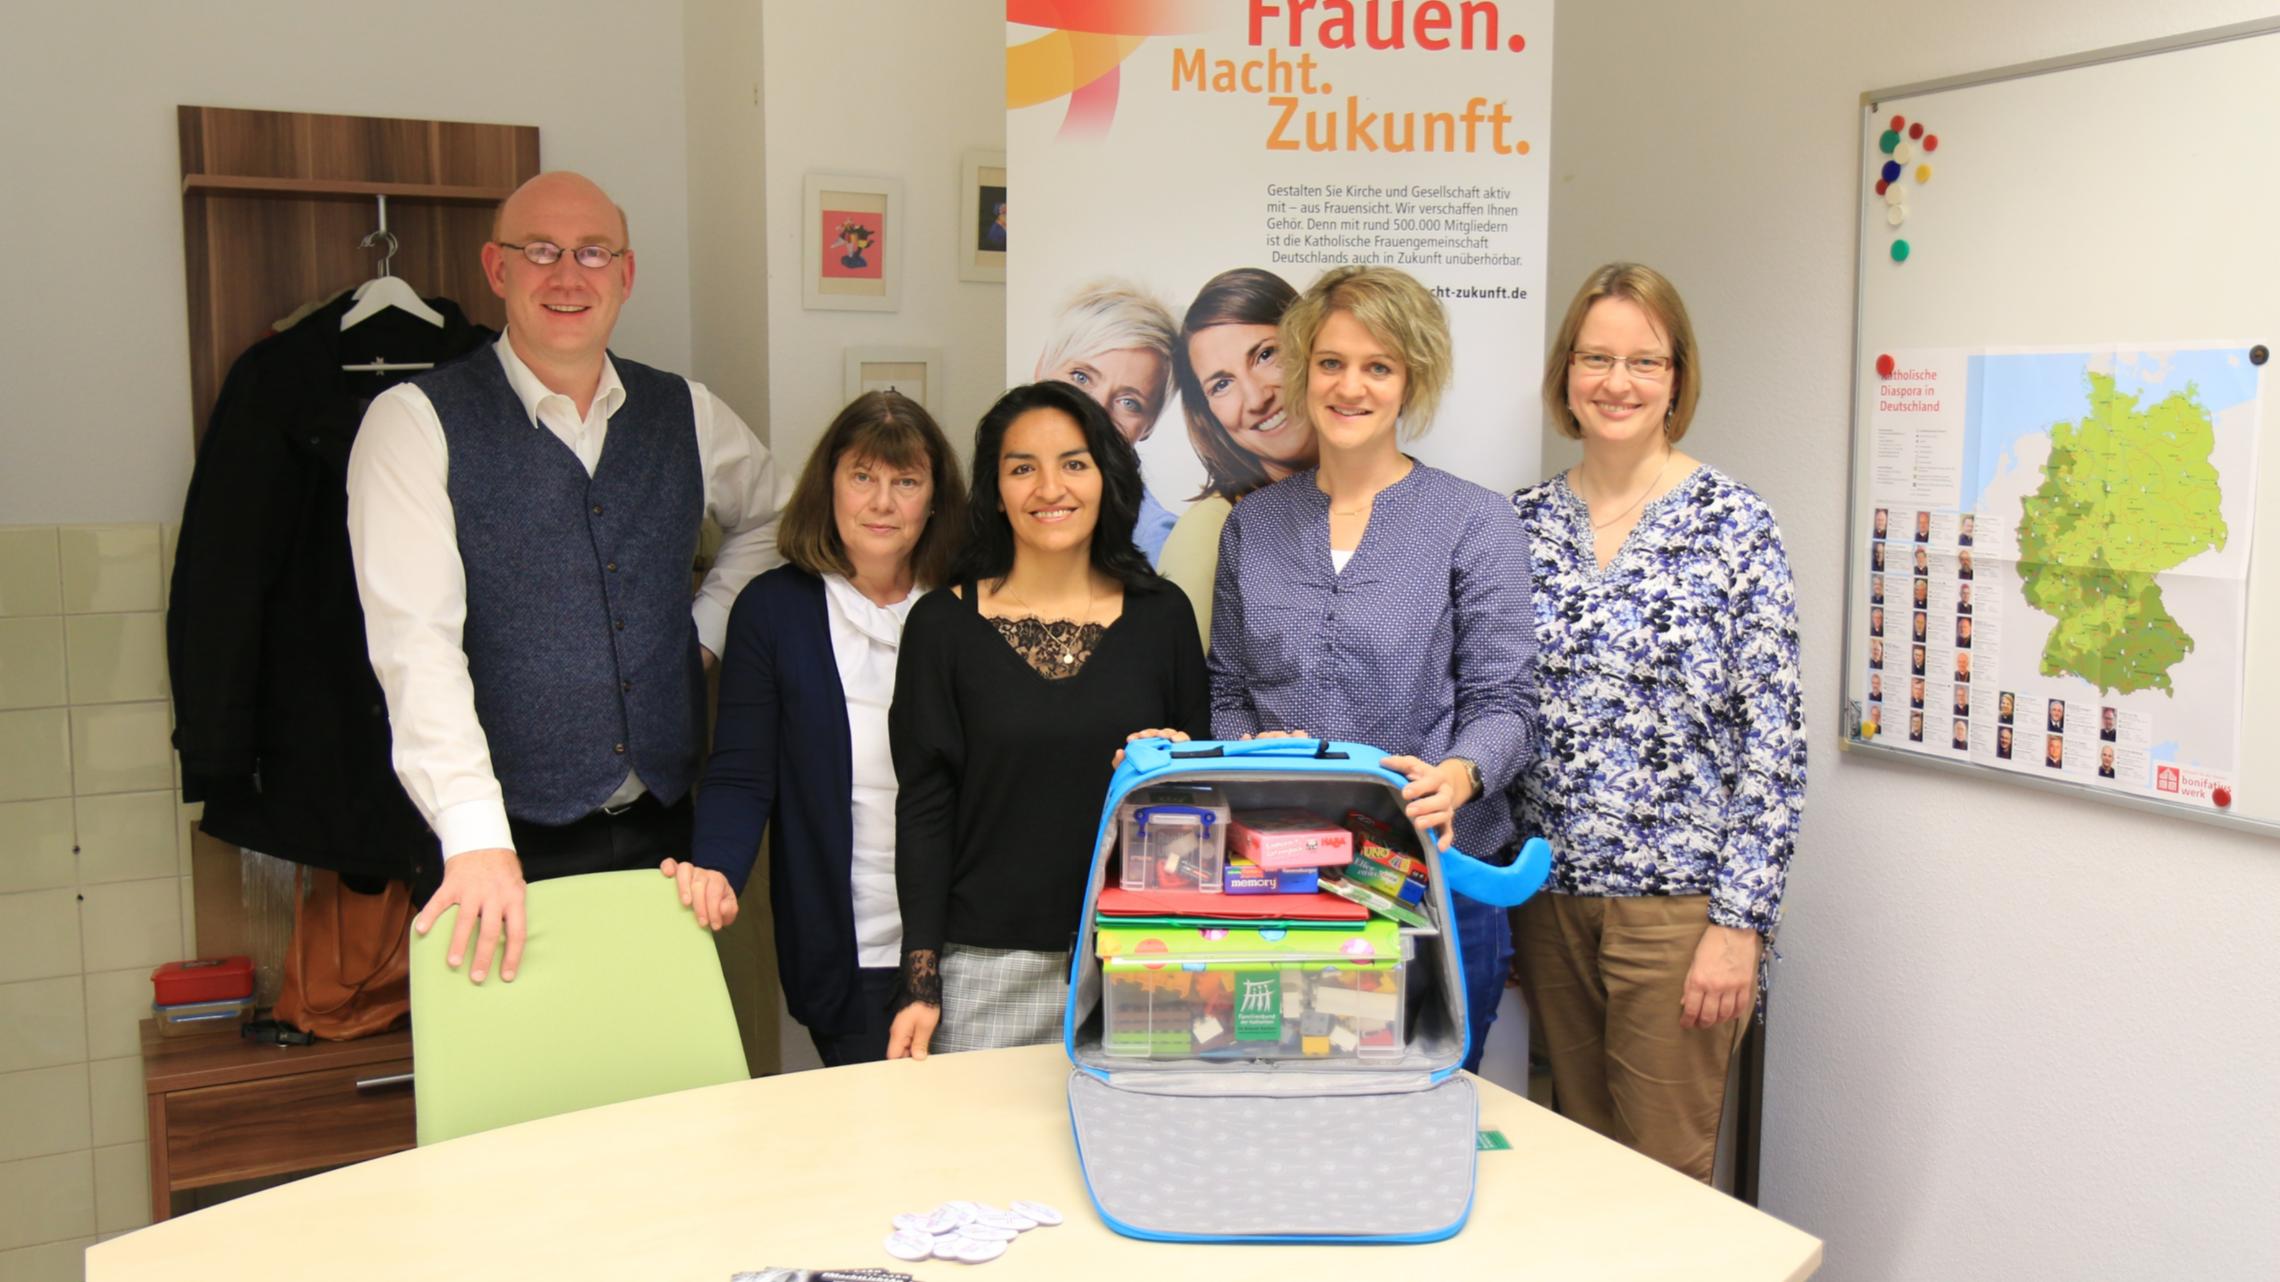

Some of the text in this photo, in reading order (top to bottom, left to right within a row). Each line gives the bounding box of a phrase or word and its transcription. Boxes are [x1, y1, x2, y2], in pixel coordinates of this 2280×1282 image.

[1248, 0, 1525, 53] Frauen.
[1171, 47, 1333, 95] Macht.
[1266, 95, 1530, 155] Zukunft.
[1267, 183, 1511, 199] Gestalten Sie Kirche und Gesellschaft aktiv
[1266, 201, 1286, 213] mit
[1300, 204, 1320, 214] aus
[1324, 201, 1392, 214] Frauensicht.
[1395, 202, 1416, 214] Wir
[1418, 202, 1484, 215] verschaffen
[1487, 203, 1518, 216] Ihnen
[1266, 217, 1508, 235] Gehör. Denn mit rund 500.000 Mitgliedern
[1266, 234, 1489, 250] ist die Katholische Frauengemeinschaft
[1272, 250, 1523, 266] Deutschlands auch in Zukunft unüberhörbar.
[1430, 285, 1528, 299] cht-zukunft.de
[1880, 368, 1937, 381] tholische
[1880, 384, 1935, 398] Diaspora in
[1879, 400, 1940, 412] Deutschland
[2182, 787, 2206, 799] werk
[1363, 845, 1390, 858] UNO
[1231, 878, 1277, 889] memory
